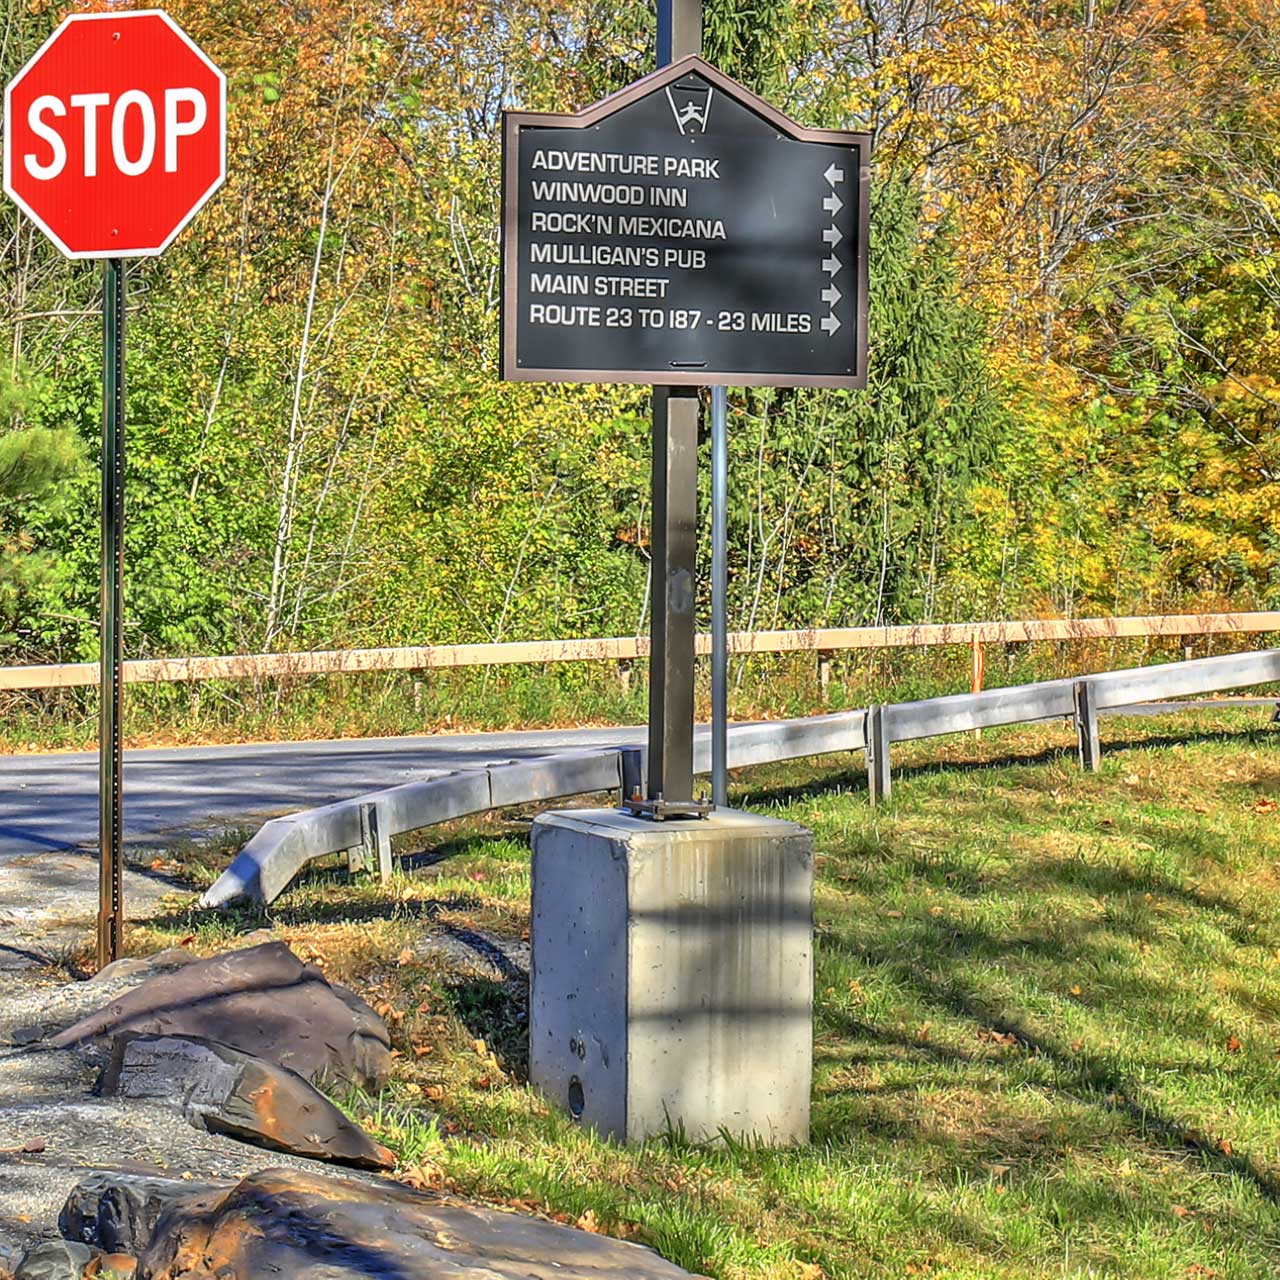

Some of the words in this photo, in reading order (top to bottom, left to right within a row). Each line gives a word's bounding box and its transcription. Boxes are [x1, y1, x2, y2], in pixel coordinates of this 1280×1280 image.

[23, 87, 208, 181] STOP
[531, 150, 658, 174] ADVENTURE
[663, 157, 719, 178] PARK
[531, 180, 644, 205] WINWOOD
[650, 187, 686, 207] INN
[531, 212, 611, 234] ROCK'N
[618, 217, 726, 239] MEXICANA
[530, 243, 658, 266] MULLIGAN'S
[664, 249, 705, 268] PUB
[530, 273, 588, 294] MAIN
[594, 276, 668, 297] STREET
[530, 304, 599, 326] ROUTE
[605, 307, 632, 326] 23
[638, 308, 662, 327] TO
[718, 311, 745, 330] 23
[751, 312, 811, 332] MILES
